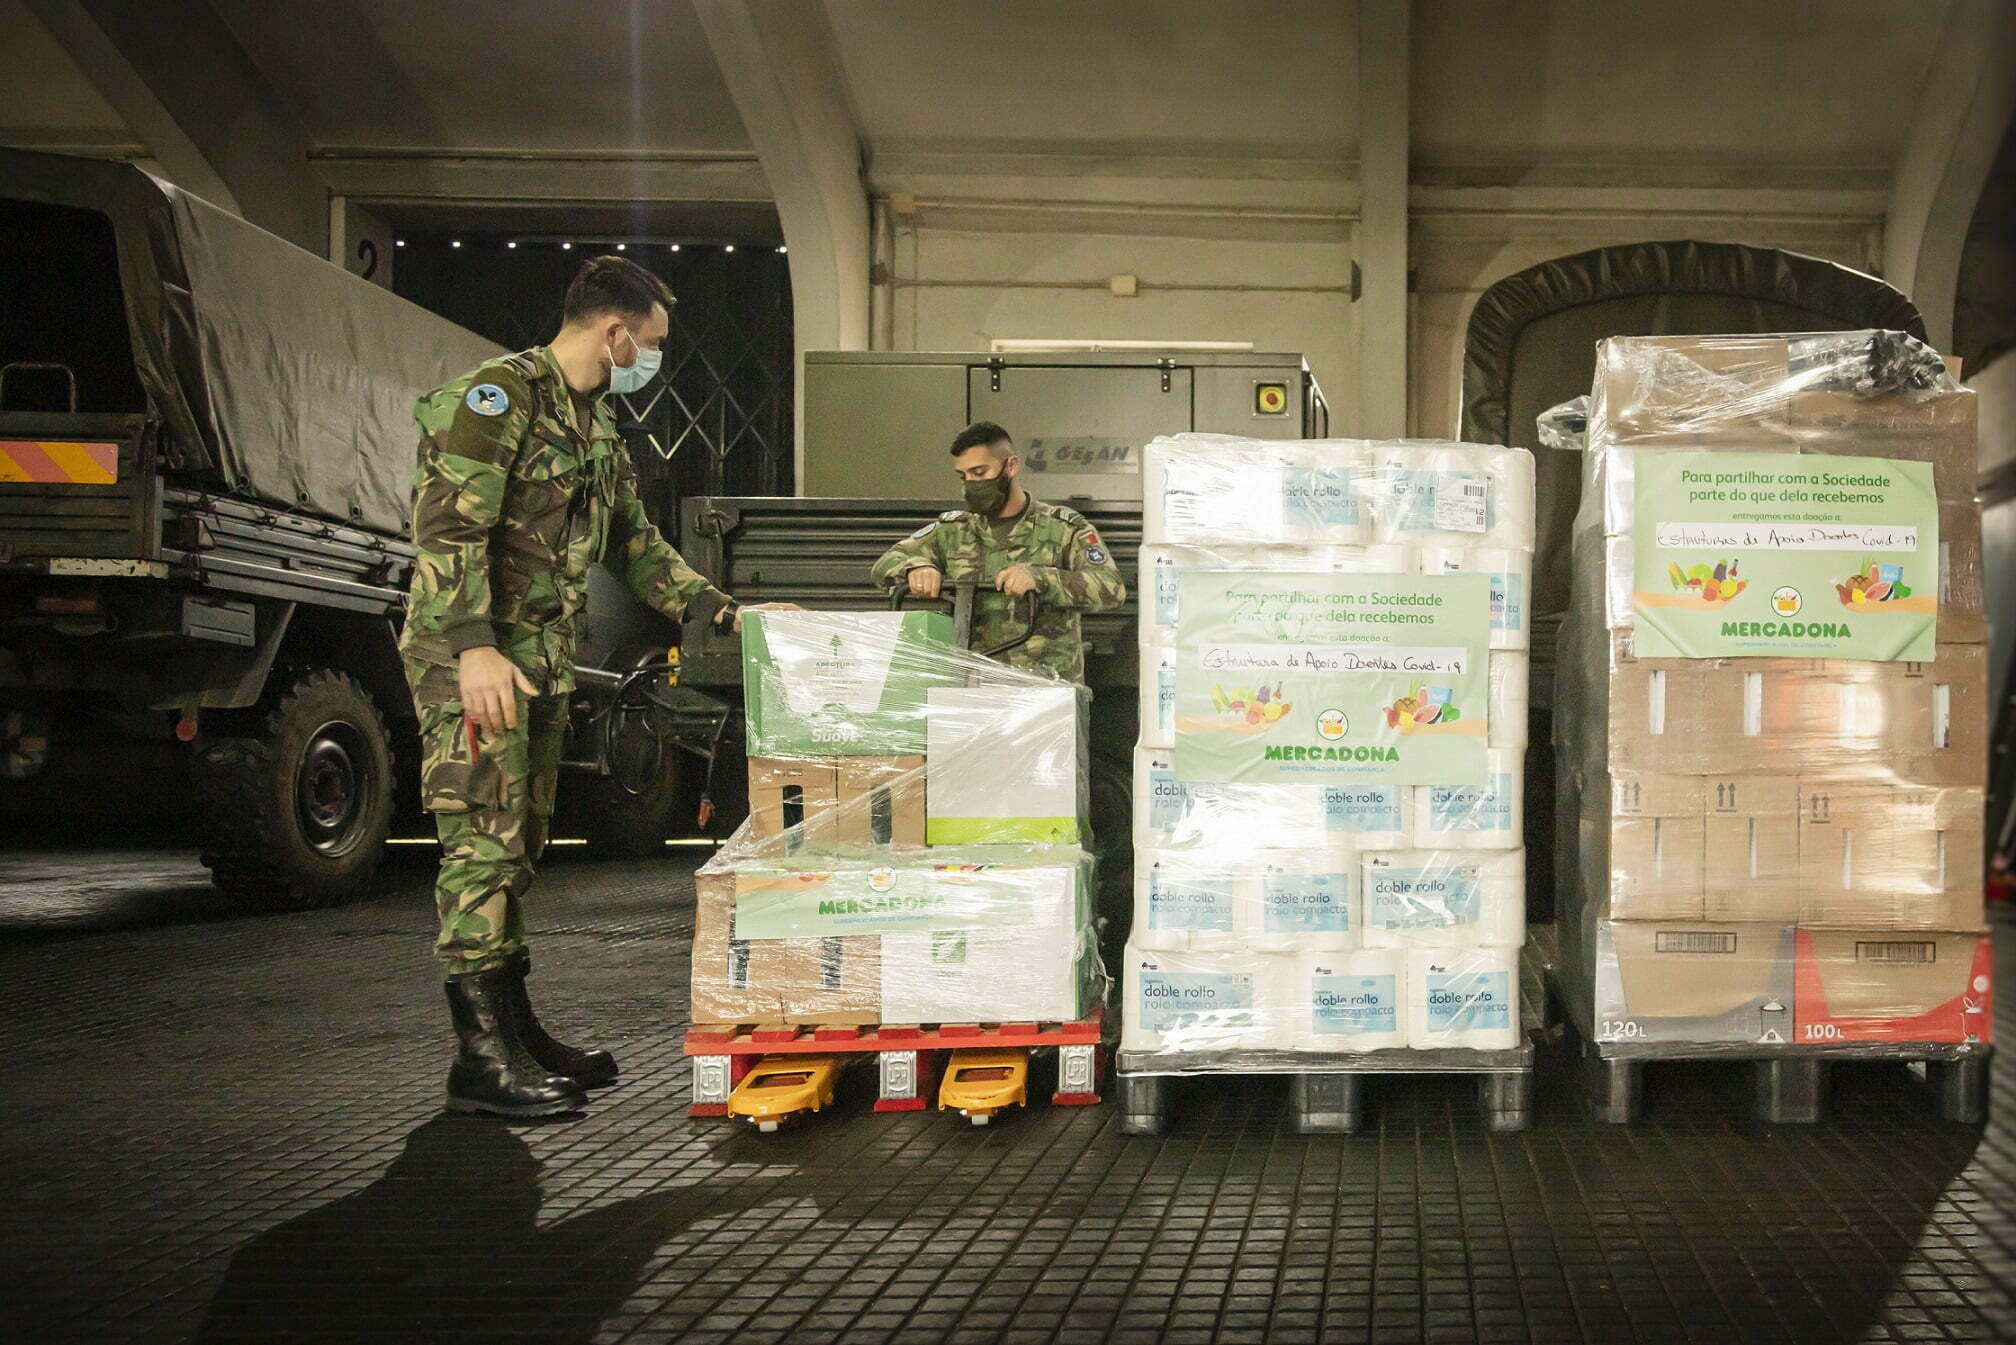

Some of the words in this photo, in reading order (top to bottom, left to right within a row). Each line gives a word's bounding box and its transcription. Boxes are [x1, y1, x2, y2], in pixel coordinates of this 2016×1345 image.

[1682, 471, 1712, 483] Para
[1716, 471, 1774, 487] partilhar
[1778, 475, 1807, 484] com
[1810, 476, 1819, 485] a
[1823, 473, 1890, 487] Sociedade
[1690, 490, 1725, 504] parte
[1729, 489, 1747, 501] do
[1751, 491, 1776, 504] que
[1780, 489, 1808, 502] dela
[1812, 490, 1884, 504] recebemos
[1732, 512, 1781, 521] entregamos
[1783, 512, 1801, 520] esta
[1803, 512, 1833, 522] doação
[1324, 594, 1354, 604] com
[1358, 596, 1367, 605] a
[1371, 592, 1443, 606] Sociedade
[1326, 610, 1356, 622] dela
[1360, 610, 1434, 624] recebemos
[1721, 622, 1852, 638] MERCADONA
[1286, 654, 1300, 667] de
[1306, 652, 1339, 669] Apoio
[1264, 745, 1400, 762] MERCADONA
[1357, 792, 1384, 804] rollo
[1376, 880, 1412, 894] doble
[1417, 880, 1446, 892] rollo
[819, 896, 944, 914] MERCADO
[1188, 892, 1215, 904] rollo
[1267, 892, 1299, 904] doble
[1303, 892, 1330, 904] rollo
[1144, 985, 1180, 998] doble
[1184, 985, 1216, 998] rollo
[1429, 992, 1462, 1004] doble
[1315, 994, 1347, 1006] doble
[1351, 994, 1378, 1004] rollo
